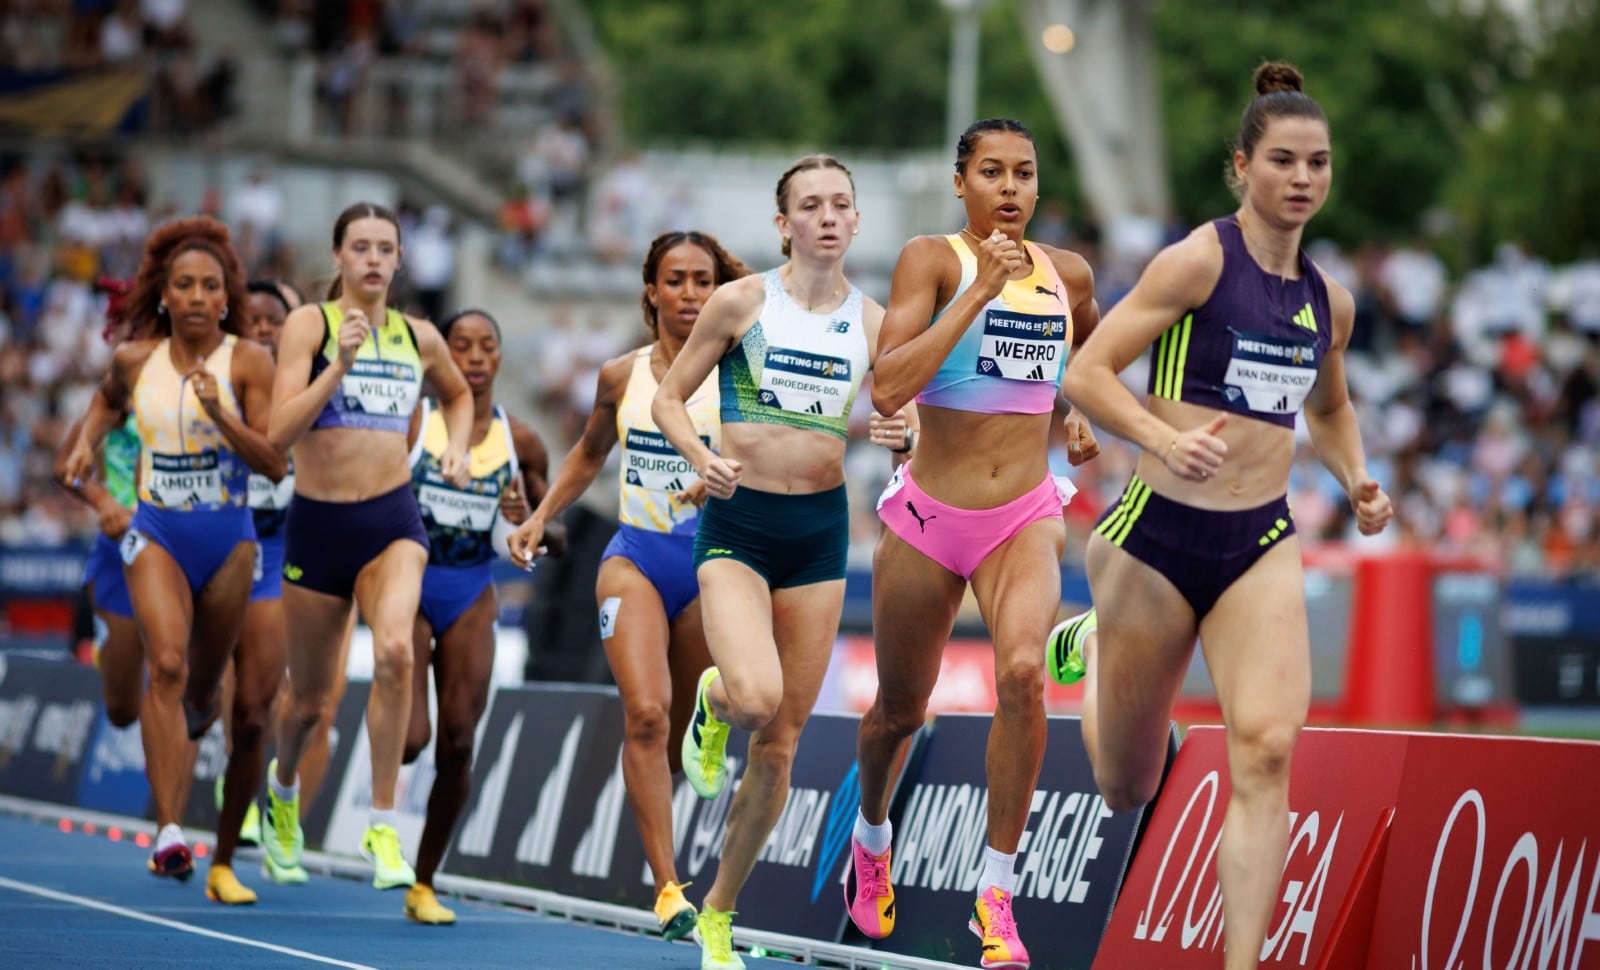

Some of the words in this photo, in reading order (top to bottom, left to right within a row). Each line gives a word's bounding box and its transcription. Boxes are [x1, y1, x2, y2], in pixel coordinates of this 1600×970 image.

[990, 317, 1032, 331] MEETING
[995, 340, 1056, 361] WERRO
[1237, 339, 1283, 357] MEETING
[769, 352, 812, 368] MEETING
[1237, 367, 1257, 380] VAN
[1260, 371, 1279, 382] DER
[360, 382, 407, 400] WILLIS
[771, 377, 840, 396] BROEDERS-BOL
[628, 432, 665, 448] MEETING
[153, 474, 216, 491] LAMOTE
[839, 783, 988, 893] IAMOND
[1013, 789, 1114, 904] EAGUE
